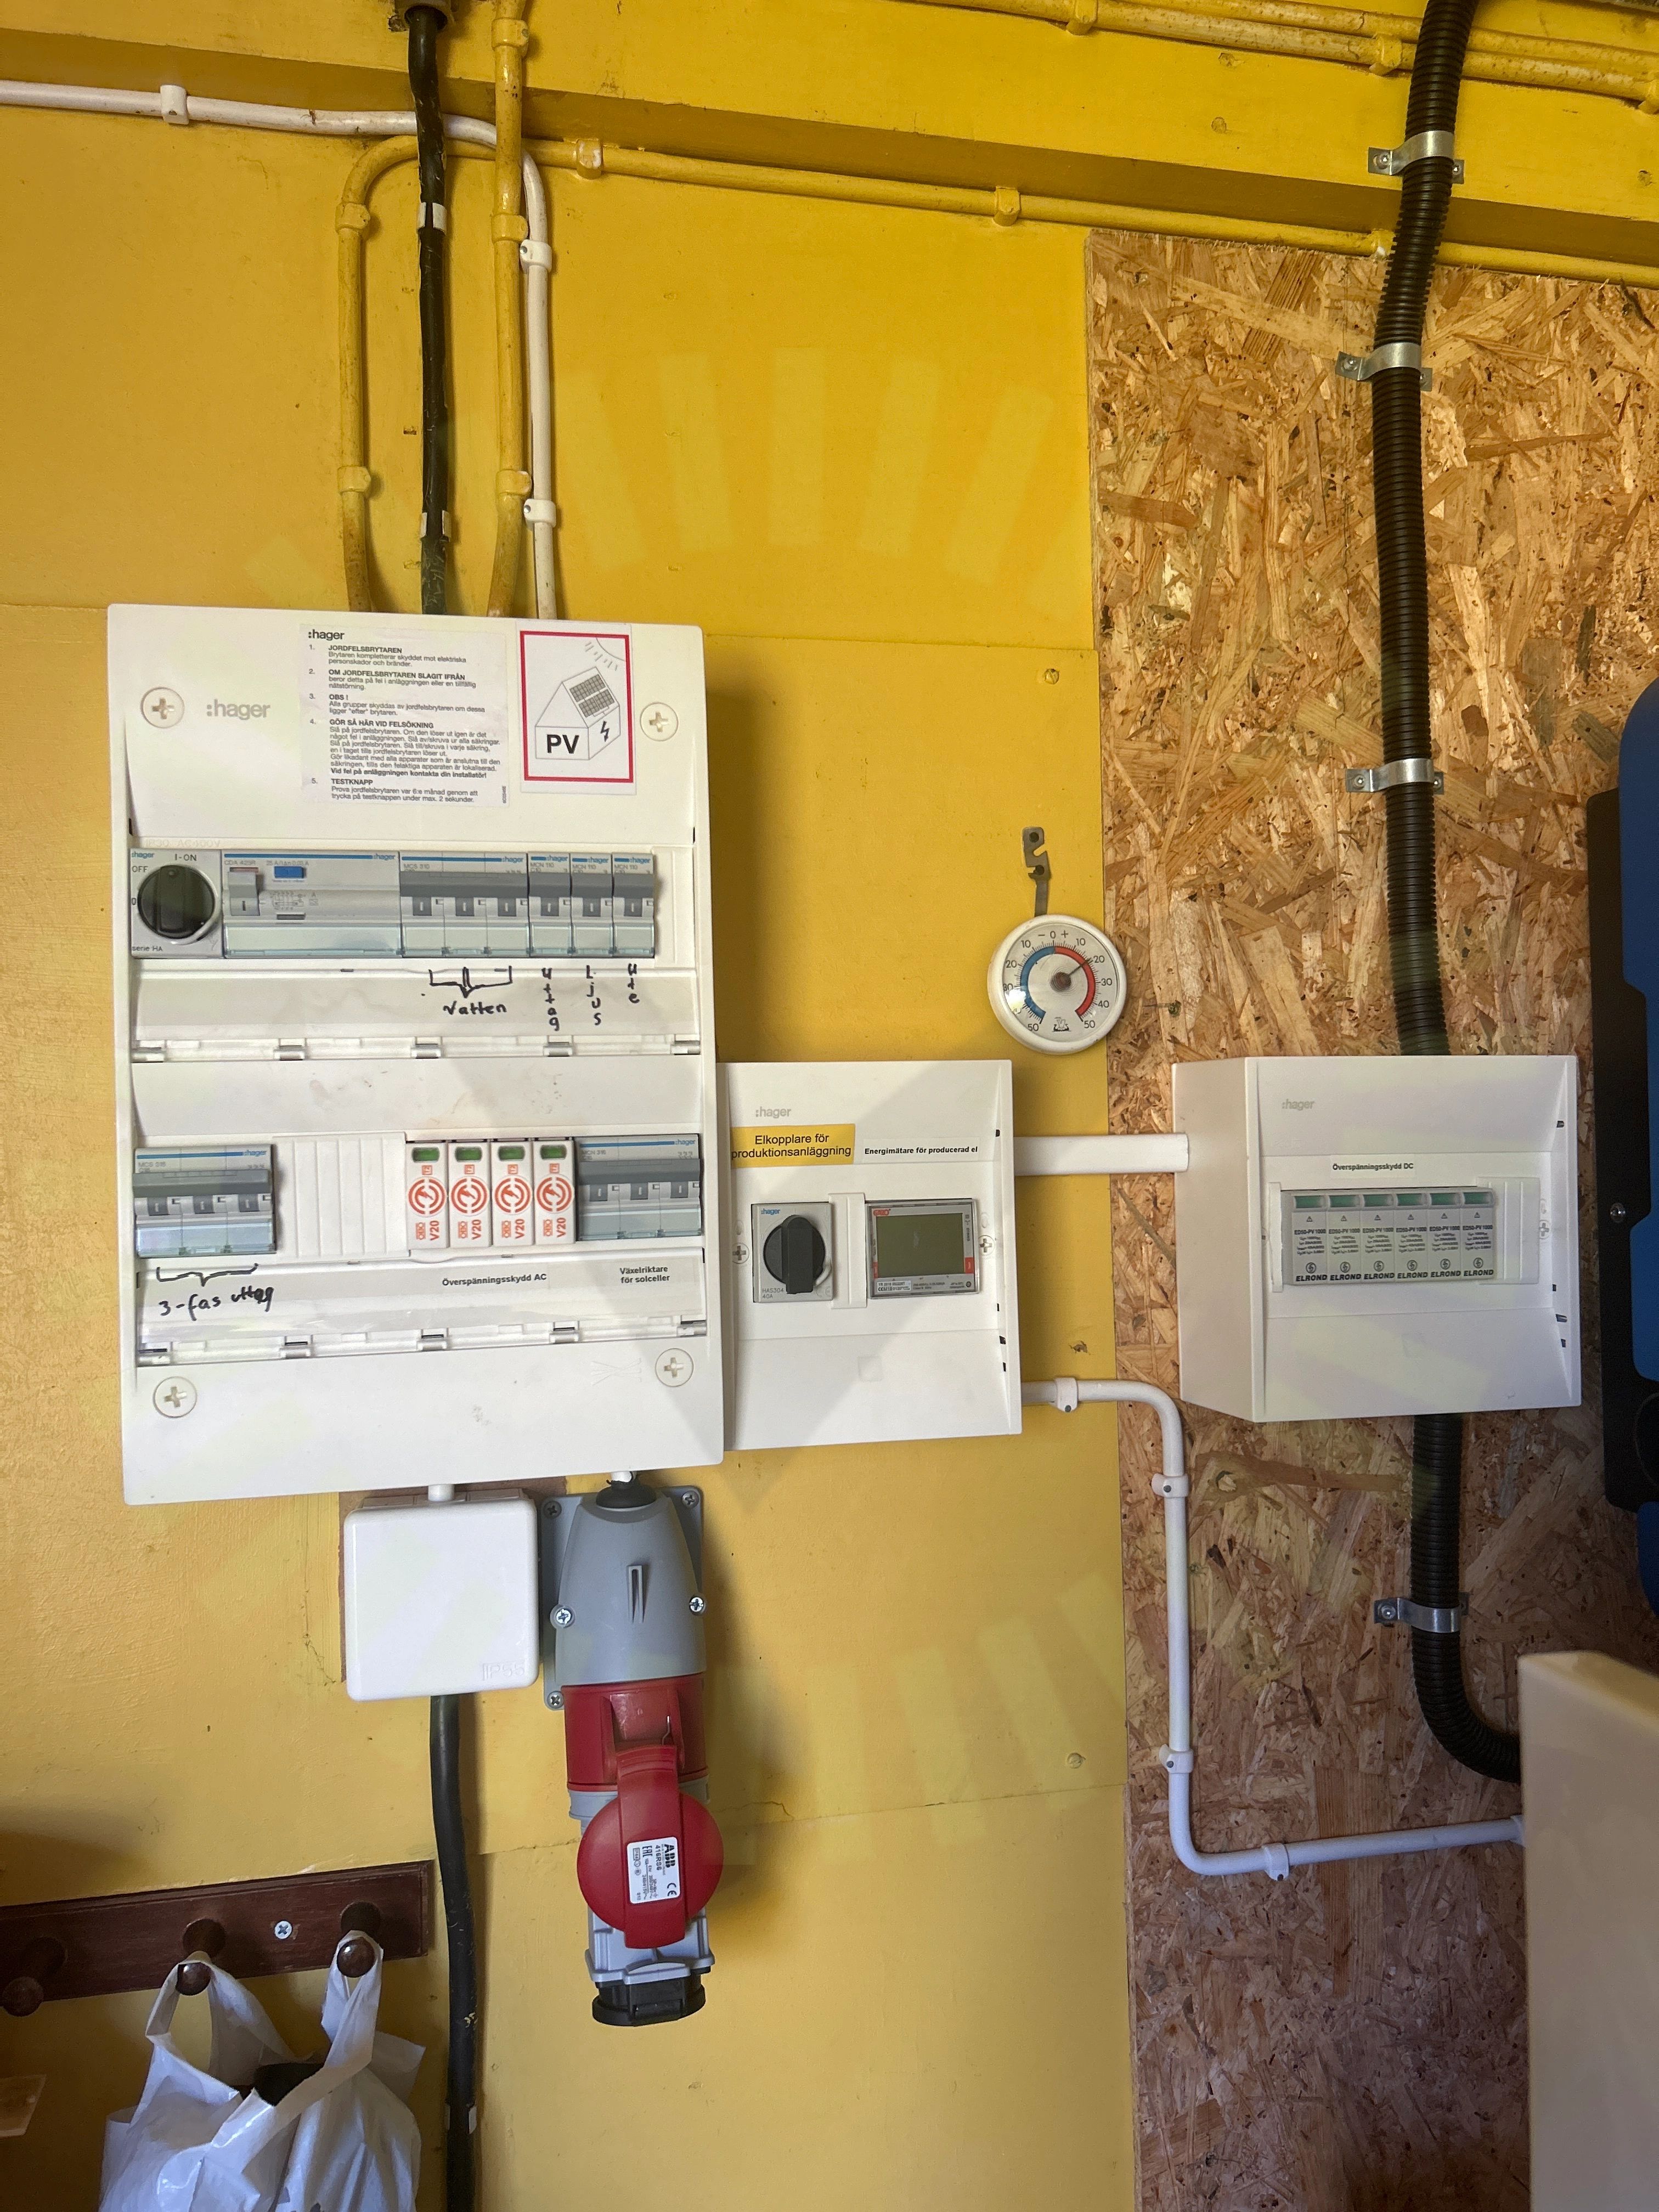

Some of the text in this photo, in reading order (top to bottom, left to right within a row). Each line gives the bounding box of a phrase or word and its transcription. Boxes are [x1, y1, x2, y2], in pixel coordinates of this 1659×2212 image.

[329, 645, 402, 653] JORDFELSBRYTAREN
[342, 670, 416, 679] JORDFELSBRYTAREN
[388, 679, 429, 687] anläggningen
[406, 704, 454, 712] jordfelsbrytaren
[546, 734, 579, 754] PV
[364, 769, 408, 777] anläggningen
[1021, 940, 1031, 949] 10
[1076, 938, 1086, 946] 10
[1094, 955, 1105, 963] 20
[1006, 960, 1017, 968] 20
[1101, 978, 1113, 986] 30
[1098, 1000, 1109, 1008] 40
[1028, 1023, 1039, 1031] 50
[1084, 1020, 1096, 1029] 50
[755, 1133, 829, 1146] Elkopplare för
[731, 1146, 851, 1160] produktionsanläggning
[865, 1148, 913, 1156] Energimätare
[928, 1146, 969, 1154] producerad
[1333, 1163, 1402, 1171] Överspänningsskydd
[430, 1220, 439, 1240] V20
[472, 1220, 482, 1240] V20
[515, 1219, 524, 1239] V20
[557, 1217, 566, 1238] V20
[619, 1266, 668, 1274] Växelriktare
[442, 1274, 532, 1286] Överspänningsskydd
[635, 1274, 670, 1283] solceller
[159, 1294, 221, 1321] 3-fas
[664, 1844, 675, 1868] ABB
